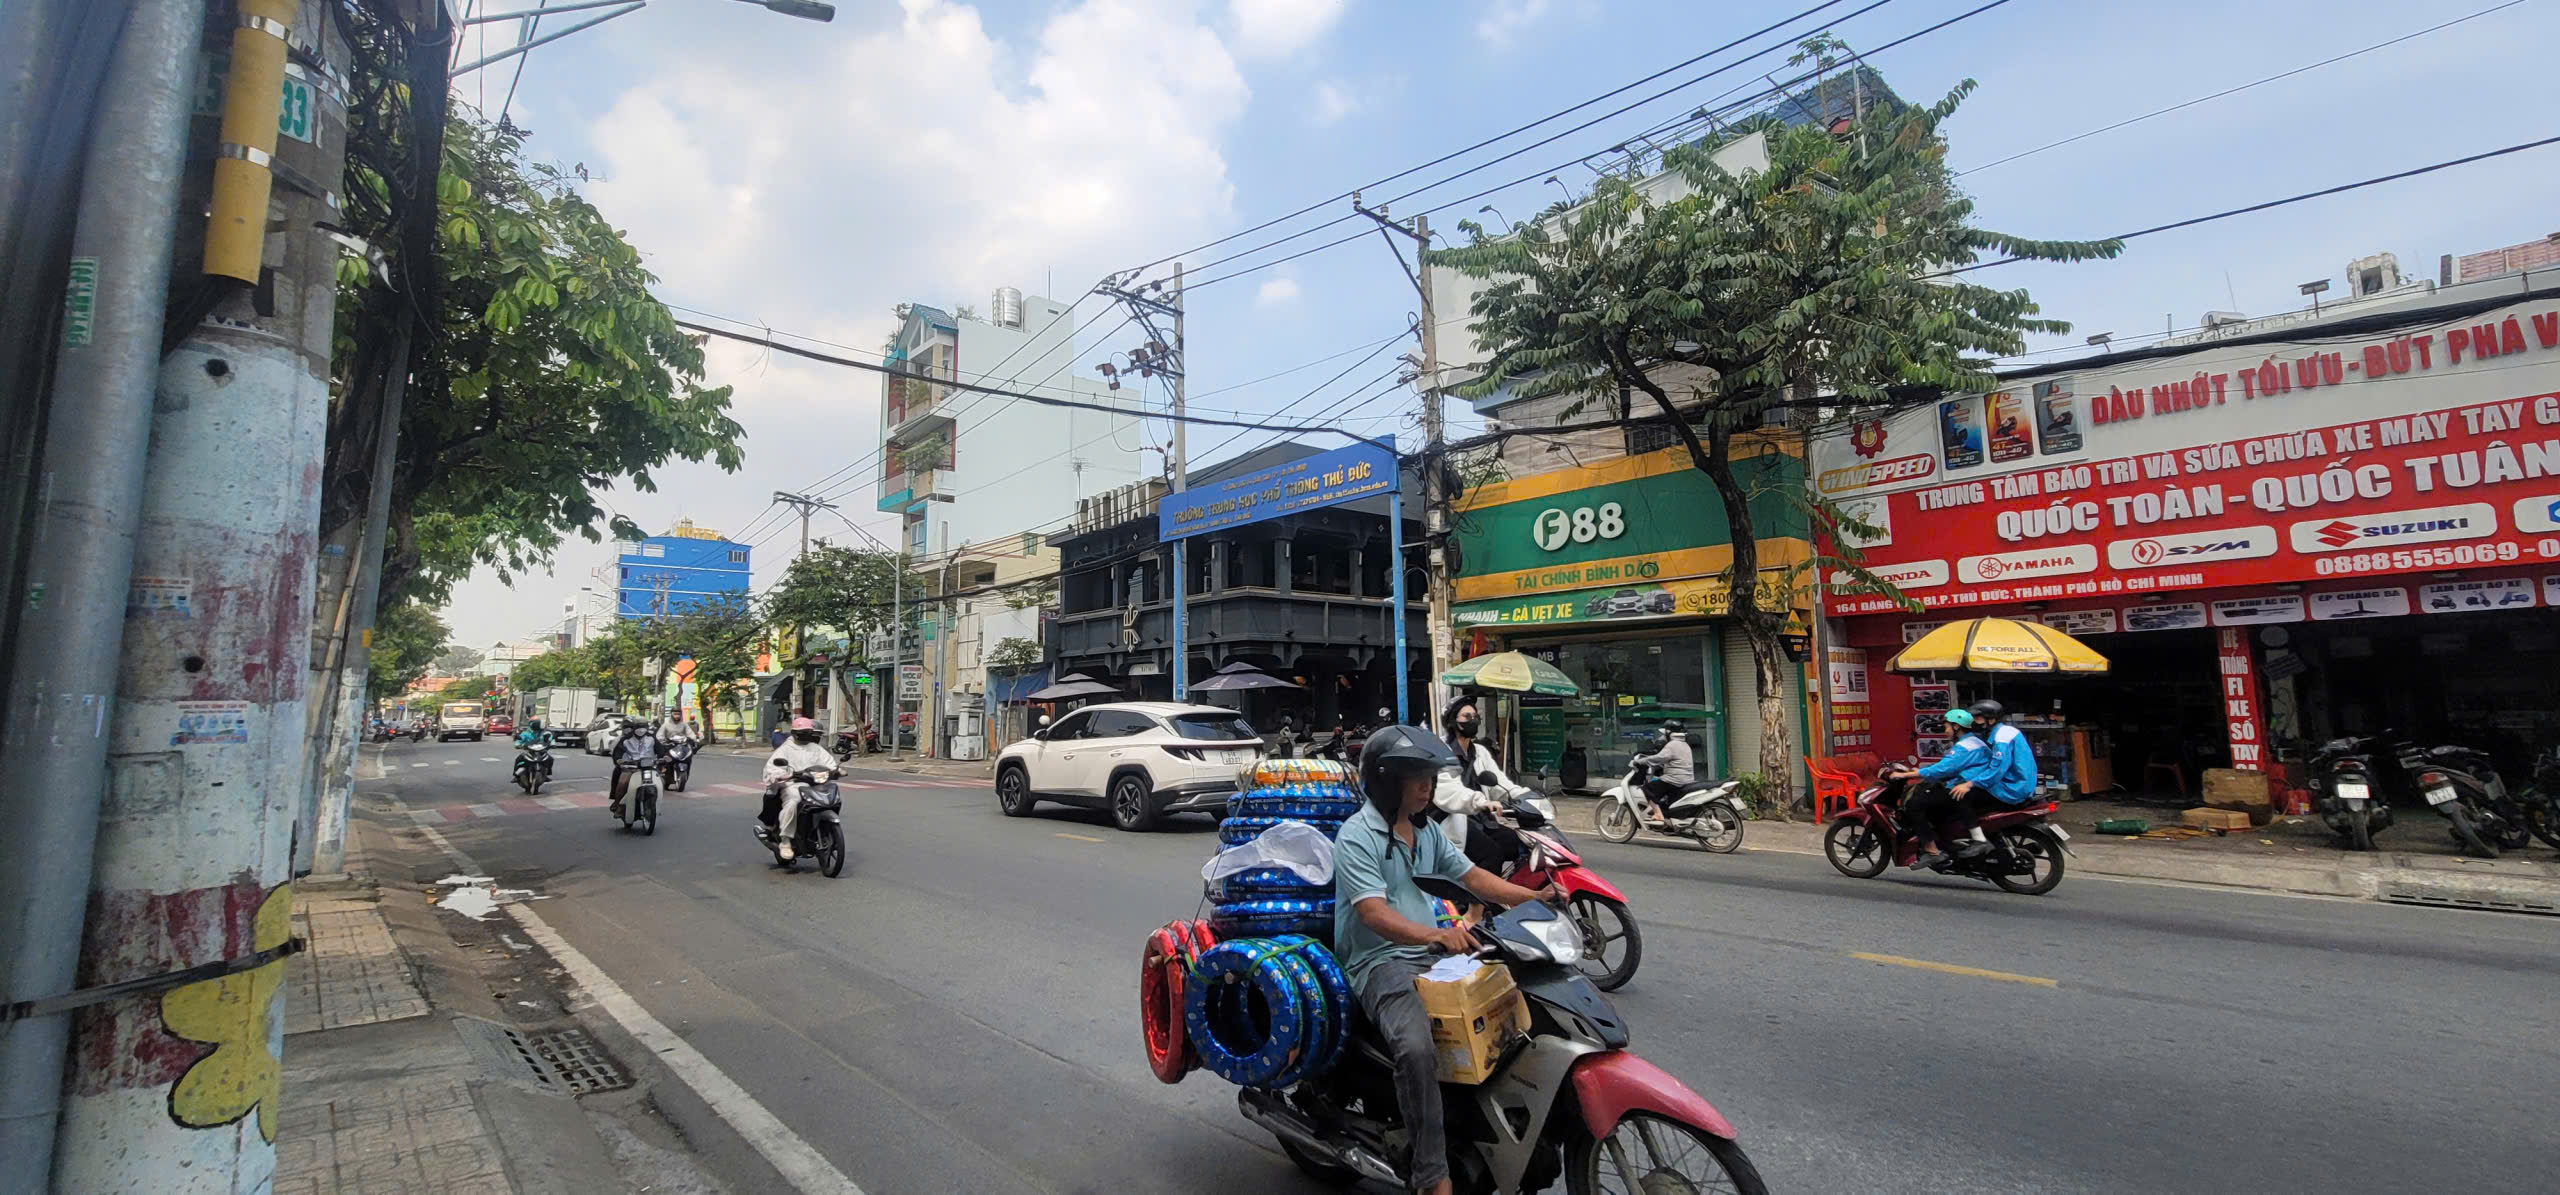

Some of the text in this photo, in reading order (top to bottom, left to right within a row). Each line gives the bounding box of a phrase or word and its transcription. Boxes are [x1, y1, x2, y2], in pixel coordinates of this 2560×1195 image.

[2446, 313, 2527, 365] PHÁ
[1915, 483, 1985, 511] TRUNG
[1990, 474, 2039, 500] TÂM
[2097, 456, 2138, 485] TRÌ
[2142, 451, 2179, 479] VÀ
[2333, 425, 2374, 454] XE
[2379, 411, 2450, 447] MÁY
[2460, 402, 2524, 435] TAY
[1208, 498, 1236, 516] TRUNG
[1322, 463, 1344, 488] THỦ
[1997, 496, 2099, 541] QUỐC
[2106, 485, 2224, 527] TOÀN
[2252, 457, 2393, 512] QUỐC
[1533, 502, 1625, 551] F88
[2362, 517, 2469, 538] SUZUKI
[2165, 540, 2251, 556] SYM
[2315, 541, 2520, 575] 0888555069
[2002, 556, 2075, 571] YAMAHA
[1515, 573, 1537, 590] TÀI
[1541, 569, 1581, 587] CHÍNH
[1835, 604, 1857, 613] 164
[2159, 573, 2204, 587] MINH
[1457, 610, 1499, 623] NHANH
[1512, 604, 1528, 621] CÀ
[1531, 604, 1553, 623] VẸT
[1556, 602, 1573, 618] XE
[2227, 677, 2244, 696] FI
[2229, 699, 2250, 717] XE
[2230, 718, 2255, 740] SỐ
[2230, 744, 2260, 761] TAY
